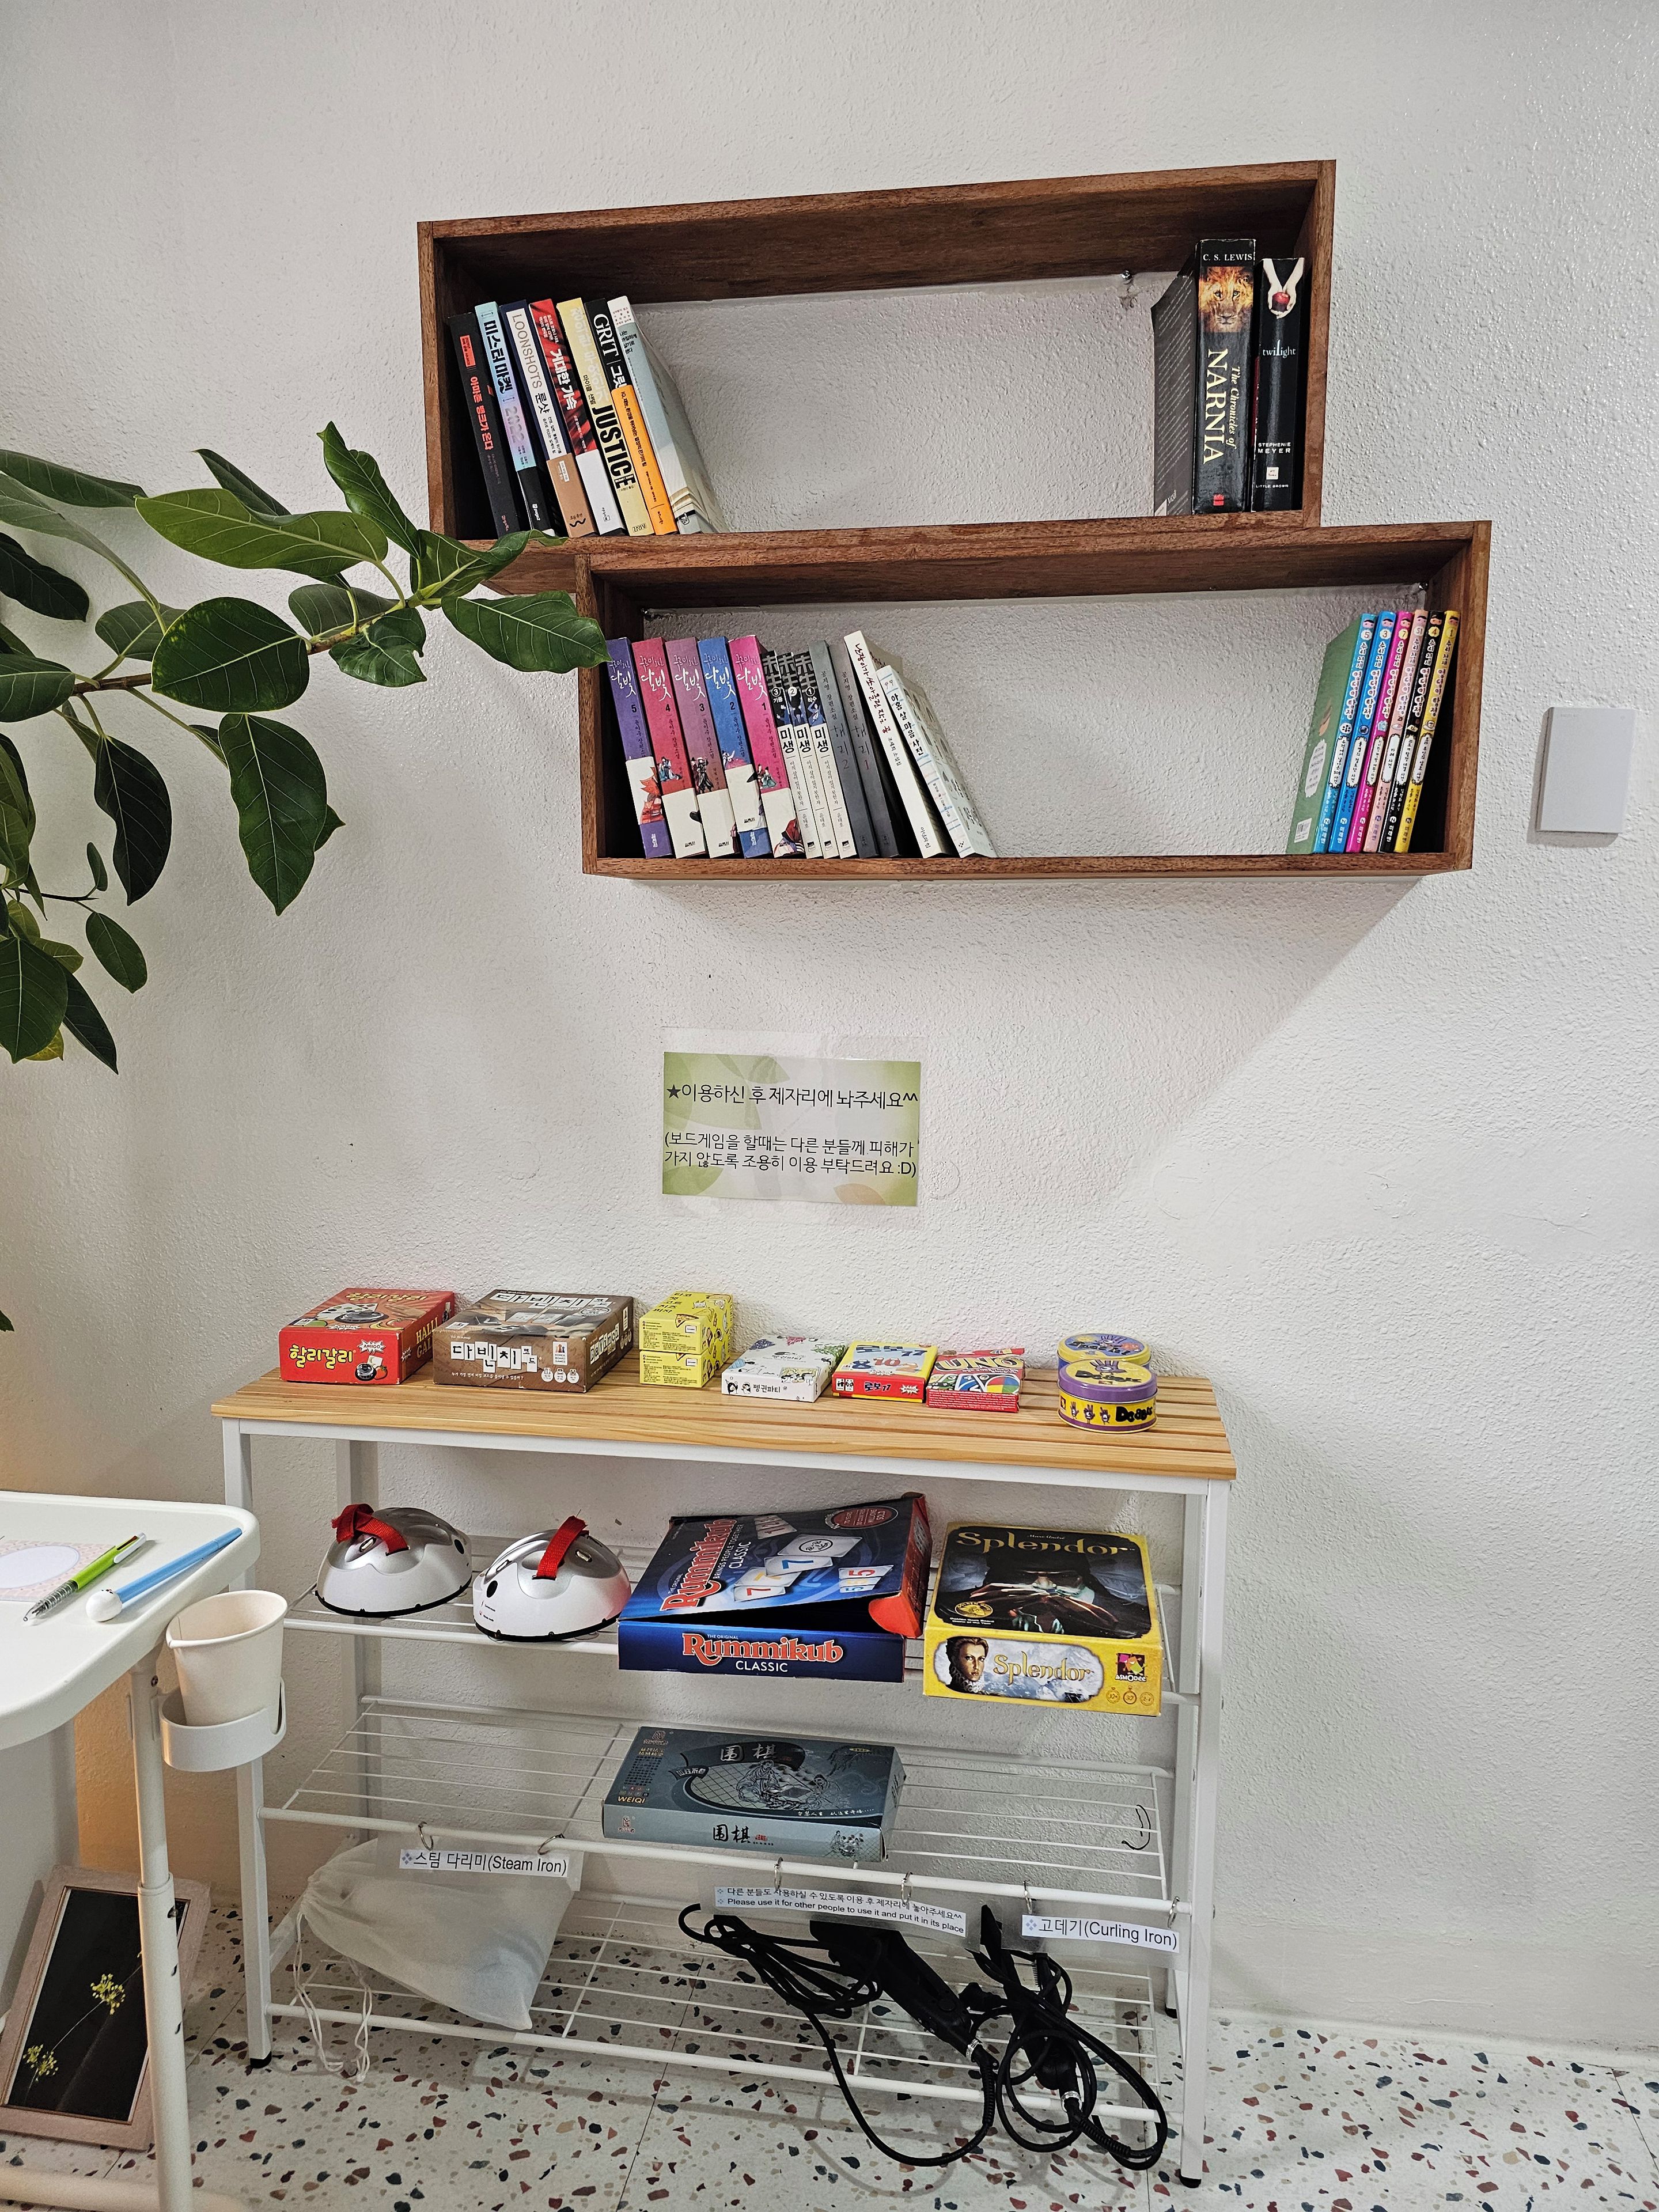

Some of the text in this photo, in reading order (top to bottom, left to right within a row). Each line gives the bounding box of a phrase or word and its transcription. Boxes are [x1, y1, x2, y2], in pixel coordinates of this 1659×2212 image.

[593, 314, 619, 356] GRIT
[1263, 339, 1296, 358] twilight
[483, 319, 514, 395] 미스터 마켓
[511, 313, 551, 415] LOONSHOTS 룬샷
[468, 375, 483, 404] 아마존
[547, 347, 578, 411] 거대한 가속
[581, 373, 592, 392] 마이클
[475, 404, 489, 431] 뱅크가
[1203, 349, 1229, 465] NARNIA
[1225, 366, 1240, 449] The Chronicles of
[504, 405, 525, 444] 2022
[480, 431, 494, 451] 온다
[592, 404, 636, 489] JUSTICE
[1378, 641, 1385, 653] 추리
[1428, 639, 1435, 652] 추리
[610, 670, 636, 698] 달빛
[641, 668, 672, 701] 달빛
[675, 668, 705, 701] 달빛
[704, 666, 736, 699] 달빛
[737, 667, 768, 700] 달빛
[855, 643, 869, 677] 난장이가
[866, 677, 881, 709] 쏘아올린
[882, 725, 891, 734] 공
[1369, 670, 1380, 697] 엉덩이
[1418, 668, 1430, 695] 엉덩이
[631, 704, 637, 713] 5
[665, 704, 671, 712] 4
[699, 703, 704, 711] 3
[729, 702, 736, 710] 2
[762, 702, 767, 710] 1
[821, 671, 837, 720] 공지영 장편소설
[842, 671, 858, 720] 공지영 장편소설
[1363, 698, 1374, 718] 탐정
[1414, 696, 1424, 717] 탐정
[891, 693, 924, 756] 아홉 살 마음 사전
[780, 727, 794, 753] 미생
[797, 726, 811, 753] 미생
[815, 726, 829, 753] 미생
[842, 759, 849, 770] 2
[864, 760, 869, 770] 1
[681, 1084, 919, 1109] 이용하신 후 제자리에 놔주세요^^
[664, 1132, 914, 1158] (보드게임을 할때는 다른 분들께 피해가
[664, 1151, 916, 1179] 가지 않도록 조용히 이용 부탁드려요 :D)
[416, 1317, 438, 1344] HALLI
[289, 1344, 353, 1369] 할리갈리
[452, 1344, 536, 1367] 다빈치 코드
[936, 1354, 1024, 1370] UNO
[753, 1384, 781, 1393] 펭귄파티
[713, 1524, 744, 1580] BRINGS PEOPLE TOGETHER
[729, 1541, 752, 1569] CLASSIC
[956, 1531, 1130, 1556] Splendor
[660, 1518, 737, 1611] Rummikub
[682, 1633, 843, 1666] Rummikub
[735, 1660, 789, 1673] CLASSIC
[993, 1651, 1091, 1686] Splendor
[720, 1743, 777, 1762] 围棋
[618, 1796, 646, 1804] WEIQI
[713, 1824, 751, 1844] 围棋
[414, 1852, 567, 1876] 스팀 다리미(Steam Iron)
[727, 1888, 744, 1896] 다른
[746, 1888, 772, 1896] 분들도
[775, 1889, 806, 1899] 사용하실
[819, 1892, 845, 1903] 있도록
[847, 1895, 863, 1904] 이용
[868, 1897, 875, 1905] 후
[877, 1898, 910, 1911] 제자리에
[912, 1903, 962, 1921] 놓아주세요^^
[817, 1903, 845, 1914] people
[874, 1908, 880, 1916] it
[881, 1910, 896, 1918] and
[899, 1912, 913, 1922] put
[930, 1918, 941, 1927] its
[942, 1922, 964, 1934] place
[1039, 1919, 1177, 1950] 고데기(Curling Iron)
